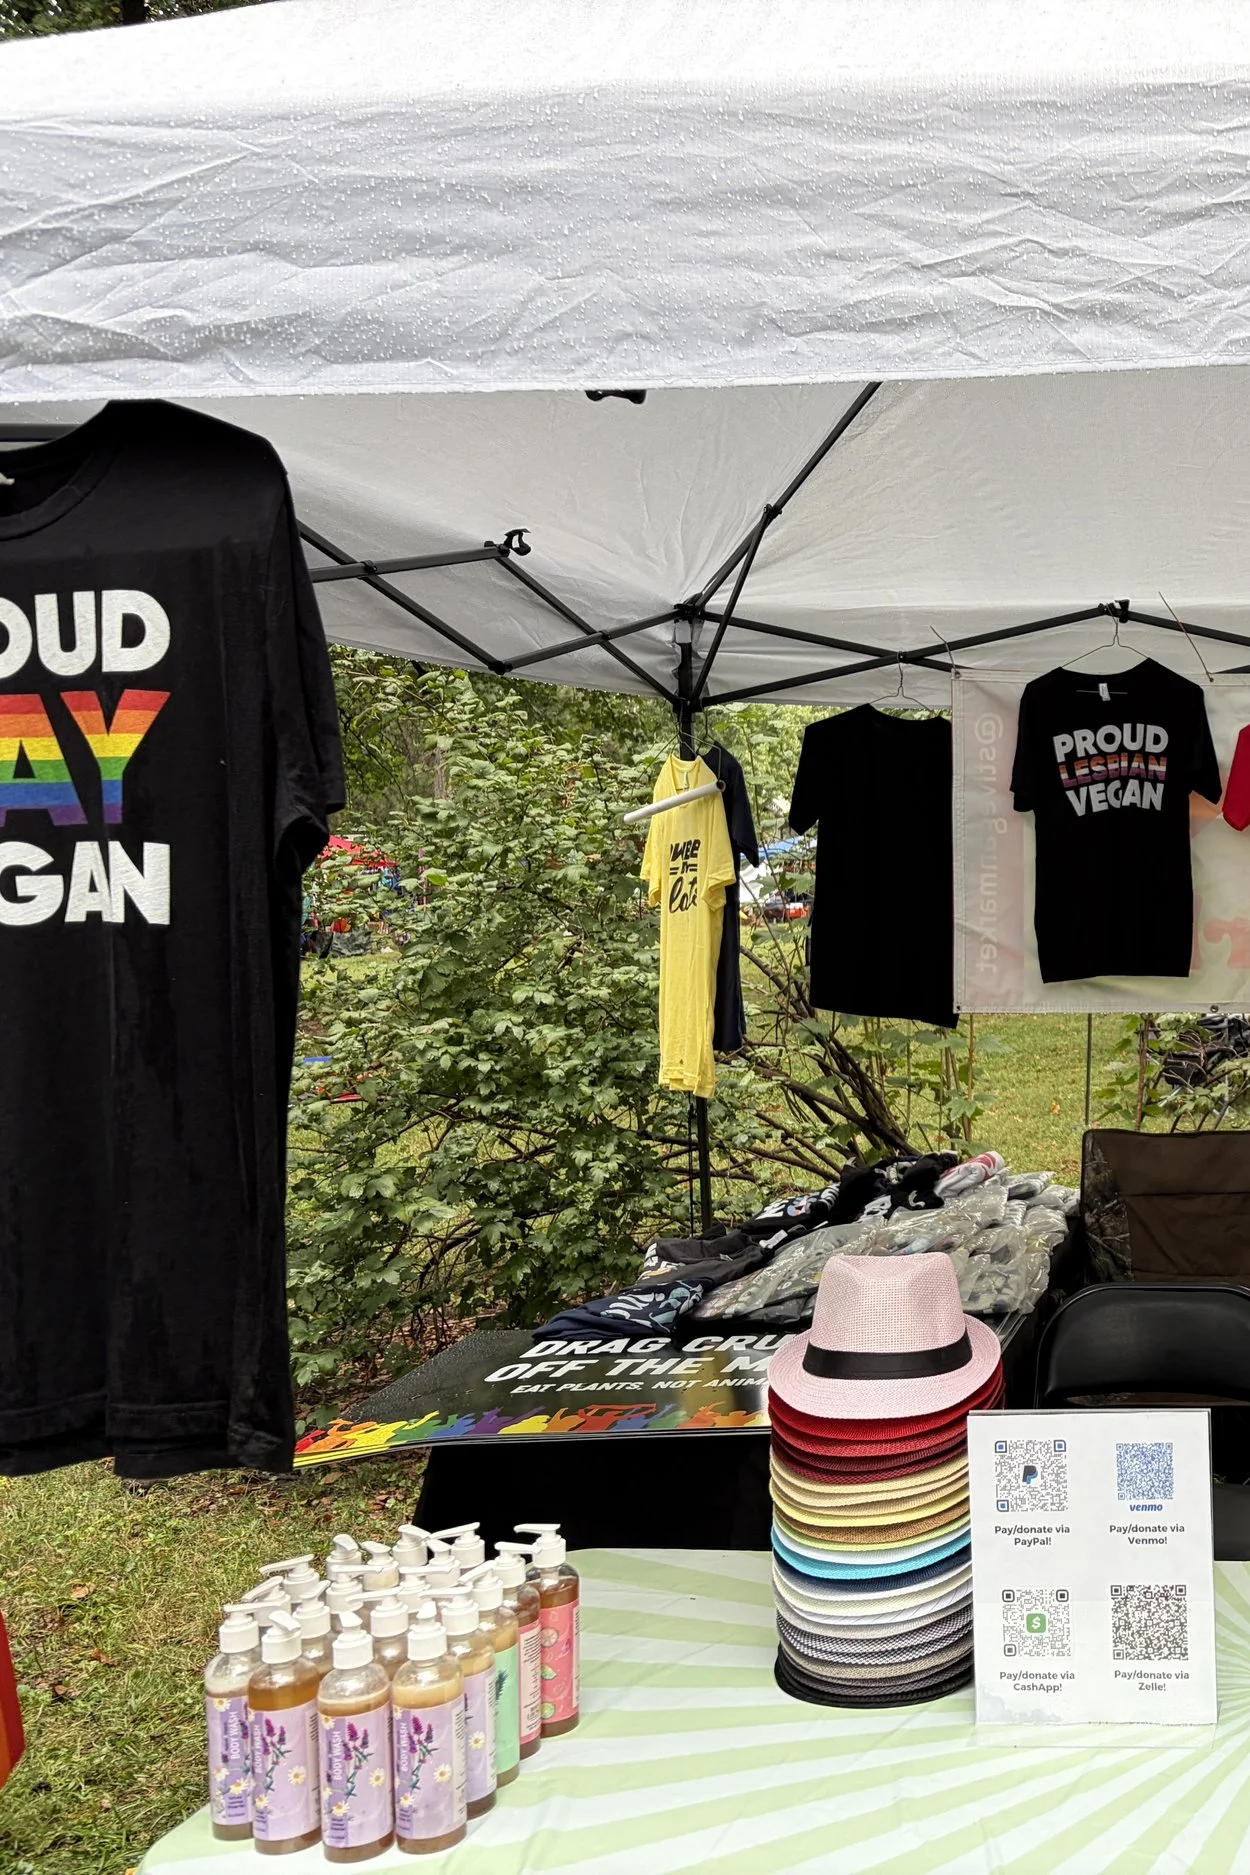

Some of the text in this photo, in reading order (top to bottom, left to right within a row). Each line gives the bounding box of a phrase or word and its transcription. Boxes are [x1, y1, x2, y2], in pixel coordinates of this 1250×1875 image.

[1053, 723, 1168, 762] PROUD
[1058, 752, 1167, 788] LESBIAN
[1066, 779, 1164, 816] VEGAN
[519, 1336, 672, 1359] DRAG
[483, 1359, 600, 1382] OFF
[605, 1357, 714, 1376] THE
[510, 1383, 556, 1394] EAT
[651, 1379, 703, 1390] NOT
[703, 1377, 768, 1388] ANIM
[1129, 1504, 1163, 1512] venmo
[994, 1524, 1070, 1535] Pay/donate via
[1109, 1523, 1185, 1534] Pay/donate via
[1014, 1537, 1052, 1547] PayPal!
[1128, 1536, 1168, 1545] Venmo!
[1000, 1671, 1075, 1682] Pay/donate via
[1114, 1670, 1189, 1681] Pay/donate via
[1013, 1682, 1062, 1693] CashApp!
[1138, 1682, 1166, 1691] Zelle!
